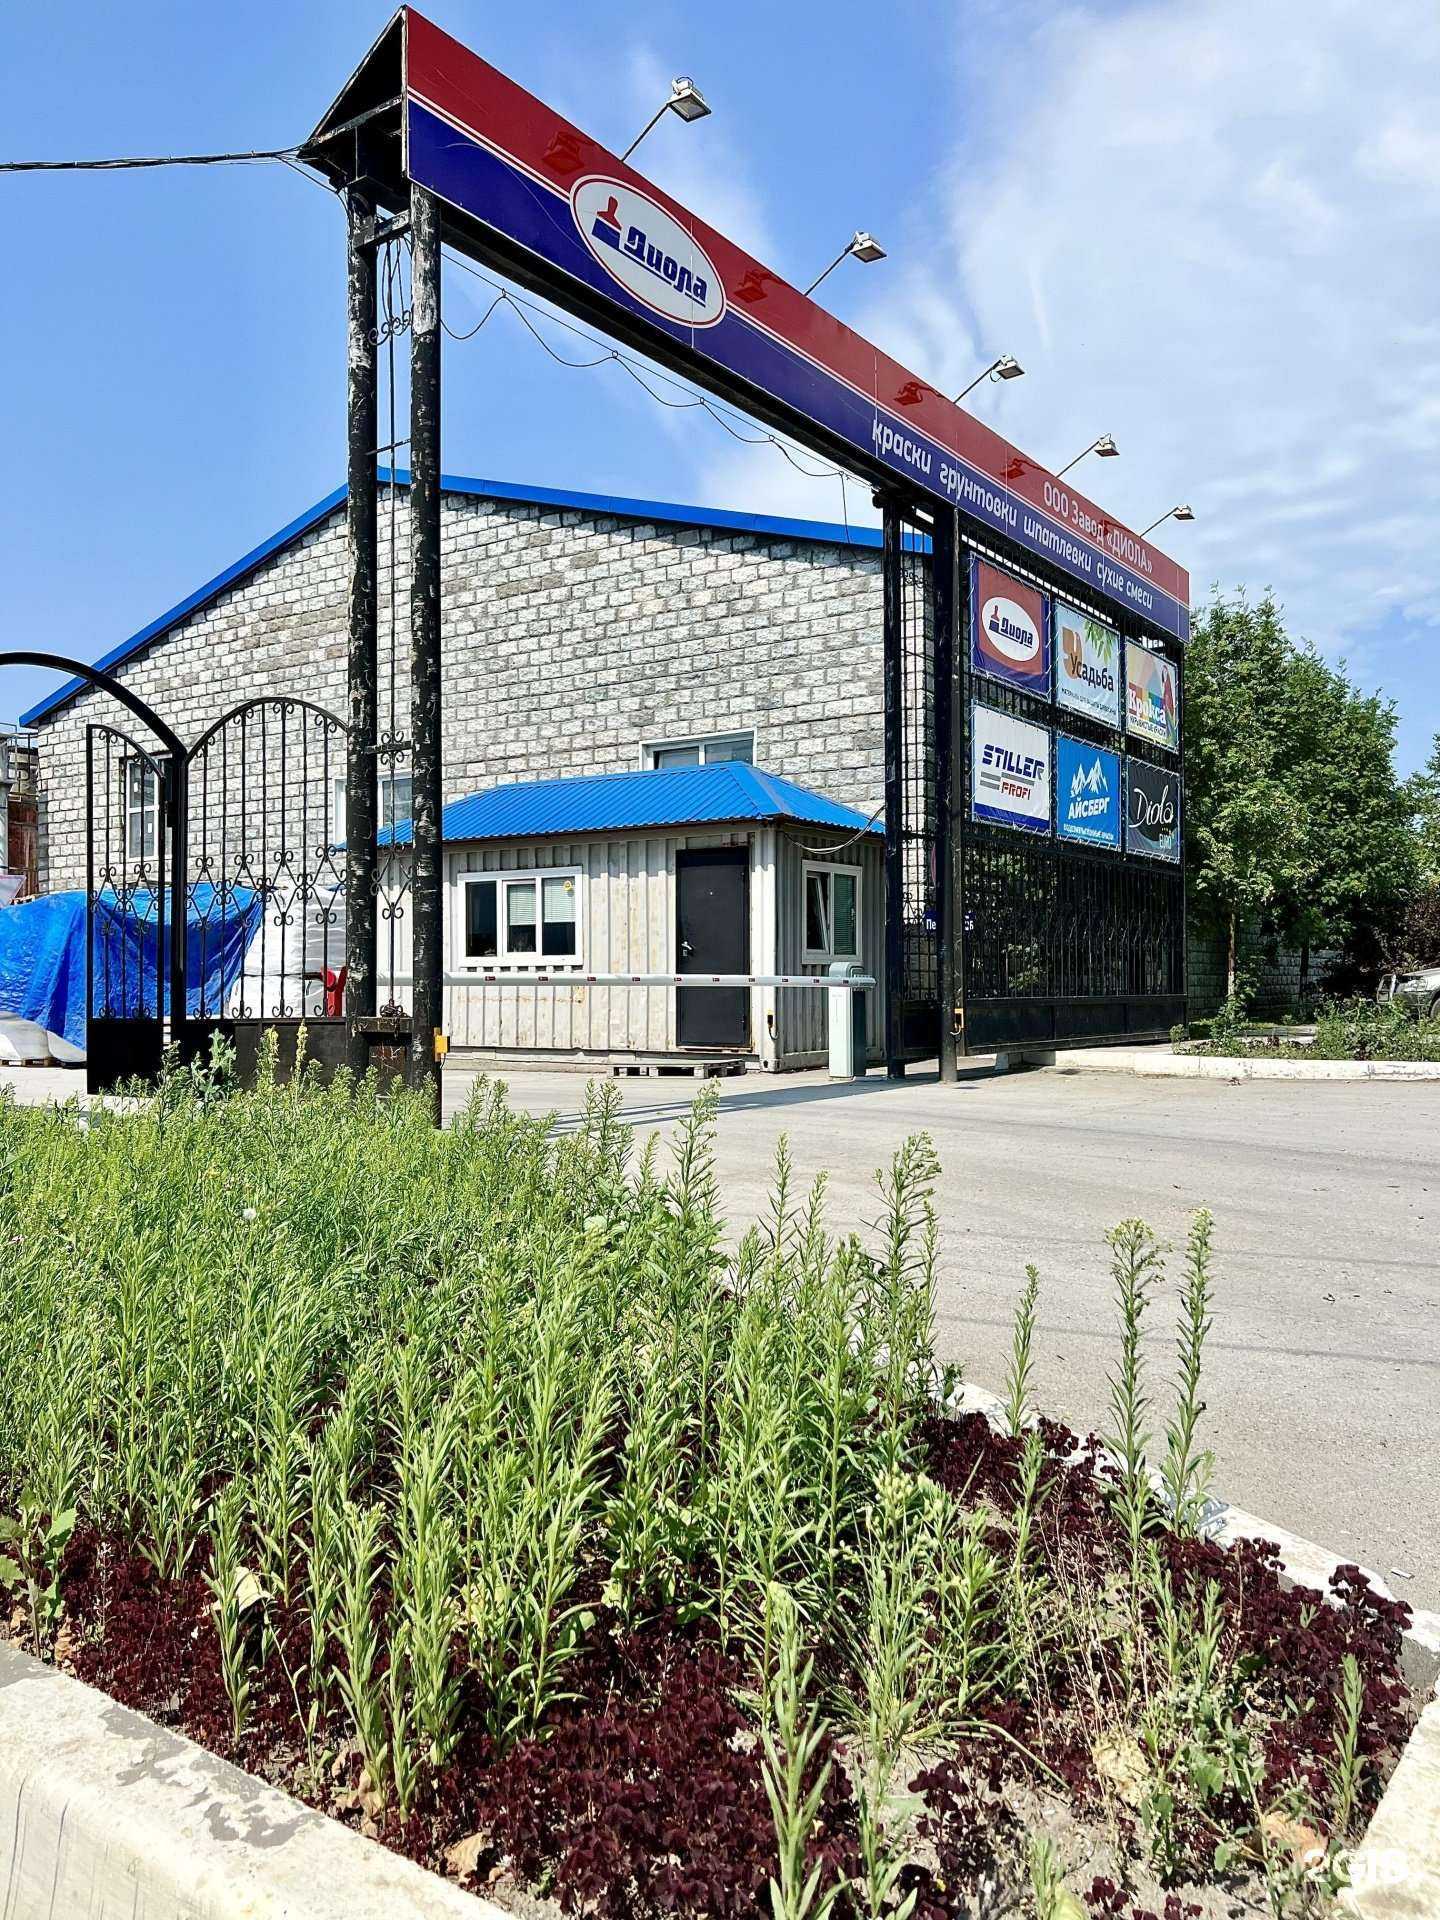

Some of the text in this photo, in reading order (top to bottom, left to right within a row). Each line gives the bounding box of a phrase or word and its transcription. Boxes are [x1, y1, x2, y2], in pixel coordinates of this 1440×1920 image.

[624, 226, 708, 302] Диола
[872, 419, 1153, 609] краски грунтовки шпатлевки сухие смеси
[1043, 481, 1069, 518] ООО
[1072, 501, 1104, 546] Завод
[1001, 617, 1034, 645] Диола
[1070, 653, 1114, 692] Усадьба
[982, 743, 1045, 781] STILLER
[1001, 781, 1032, 801] PROFI
[1068, 796, 1111, 820] АЙСБЕРГ
[1128, 785, 1174, 828] Diola
